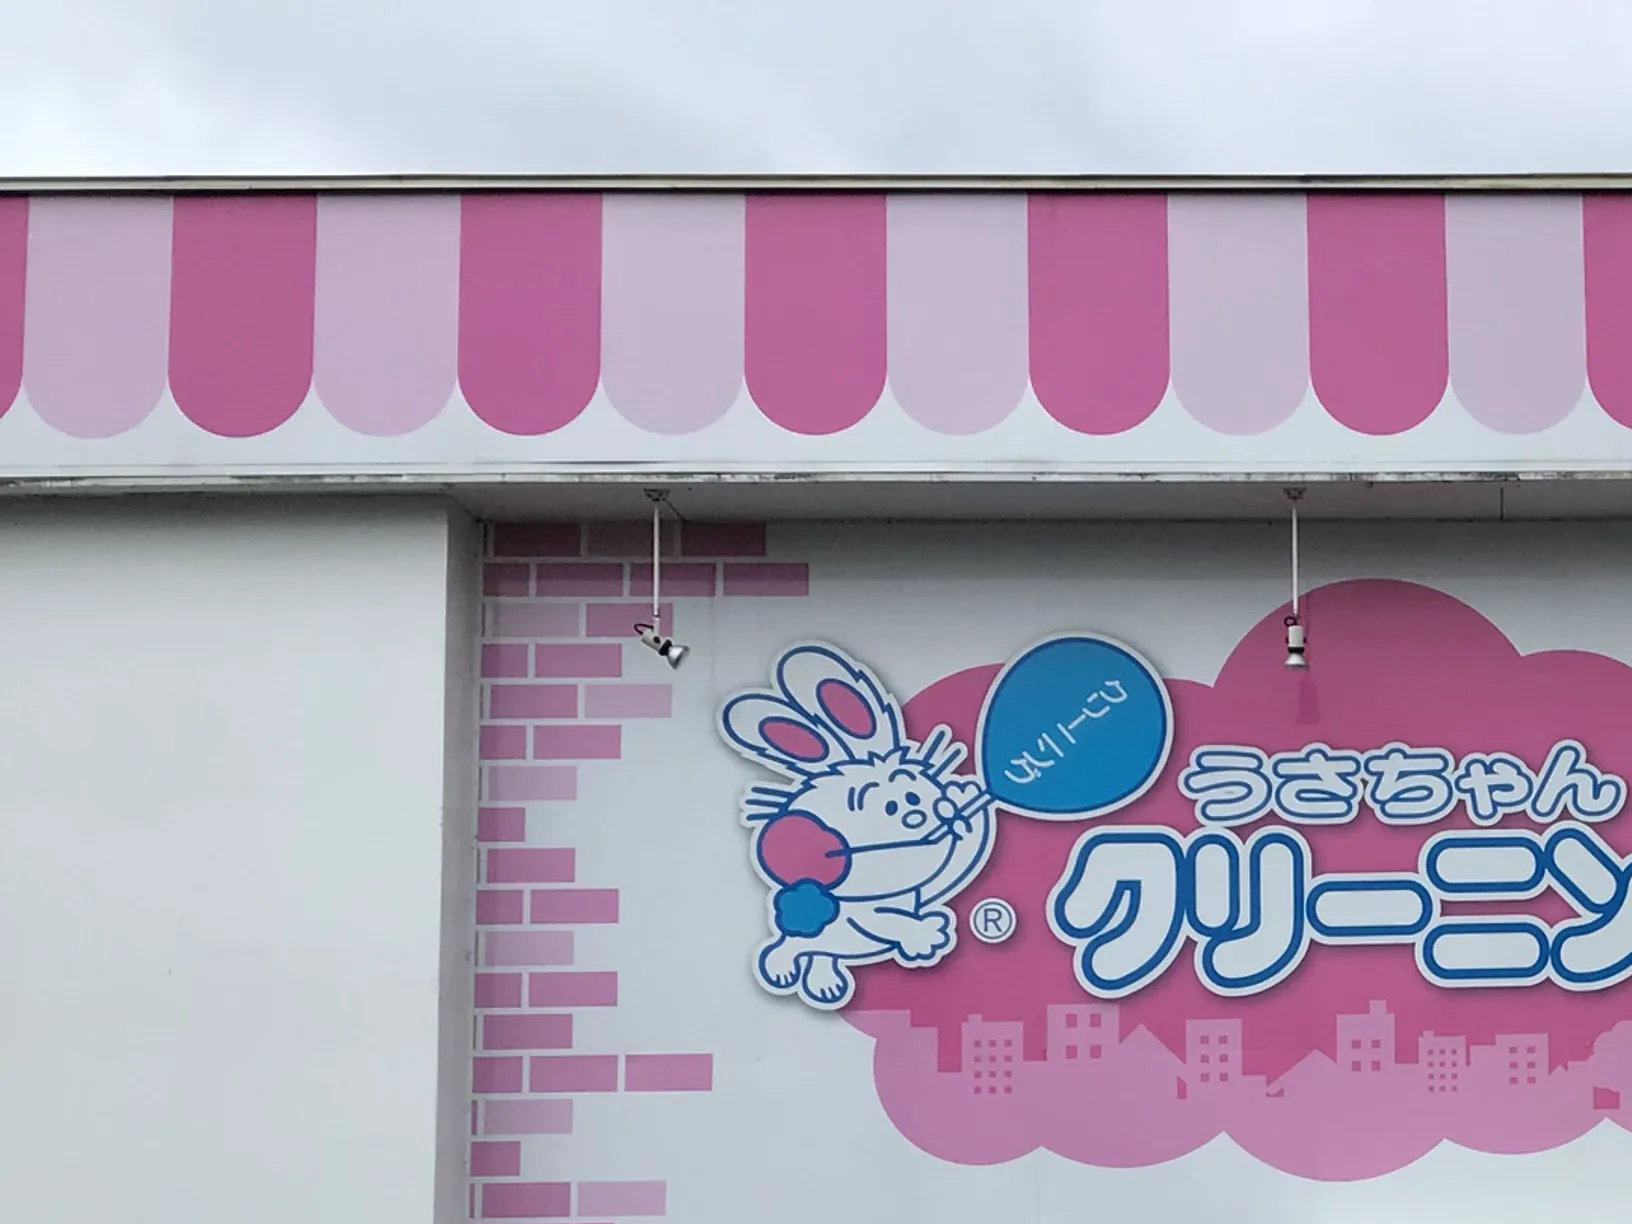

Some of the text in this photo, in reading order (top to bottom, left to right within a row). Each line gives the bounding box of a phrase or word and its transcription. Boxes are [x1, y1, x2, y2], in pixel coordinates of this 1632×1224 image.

[1180, 740, 1627, 825] うさちゃん
